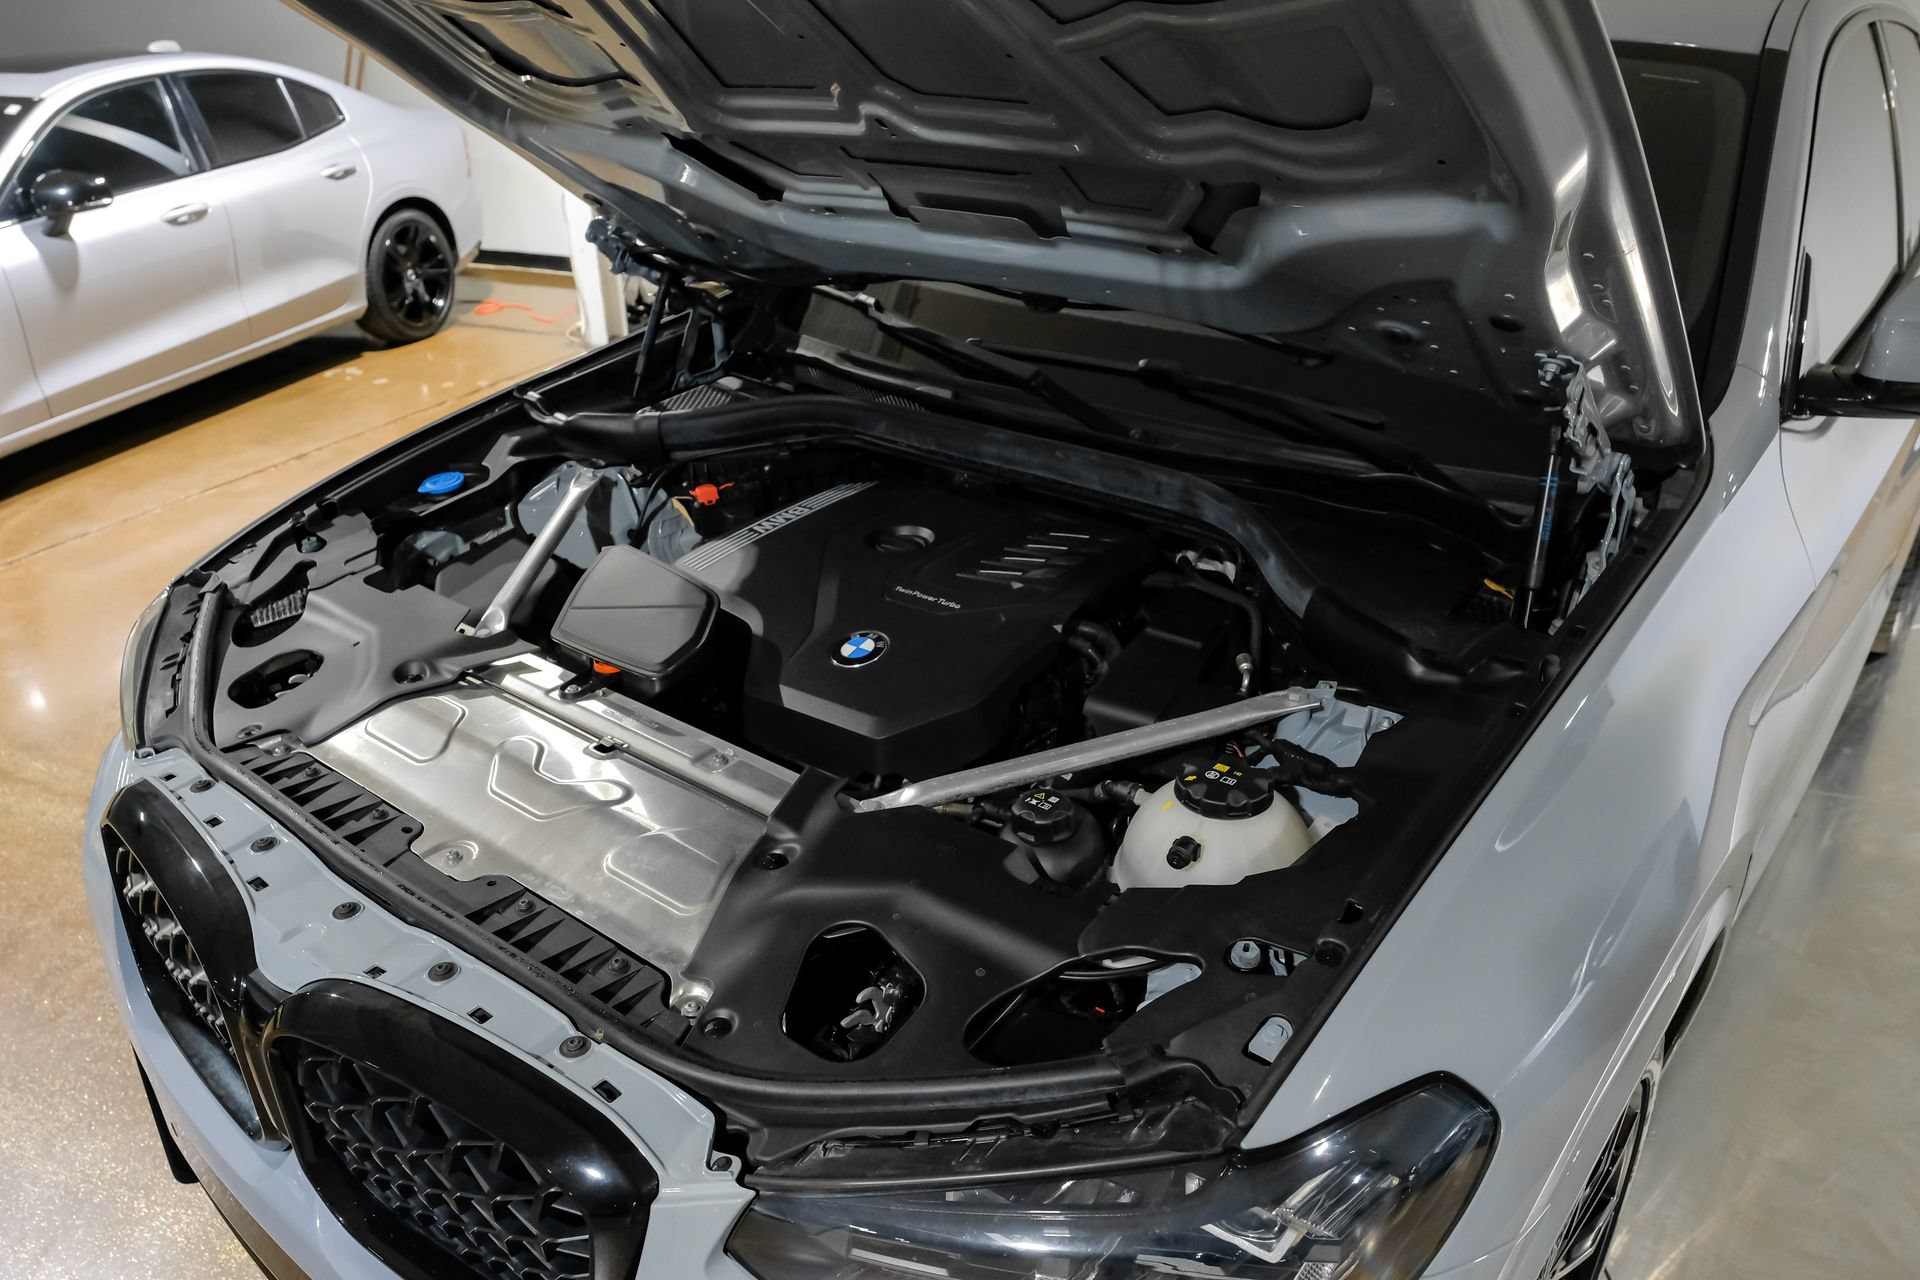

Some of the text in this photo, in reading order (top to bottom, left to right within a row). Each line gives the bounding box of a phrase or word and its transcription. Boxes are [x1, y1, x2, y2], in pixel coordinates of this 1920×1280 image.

[752, 506, 811, 534] BMW
[895, 585, 961, 609] TwinPower Turbo
